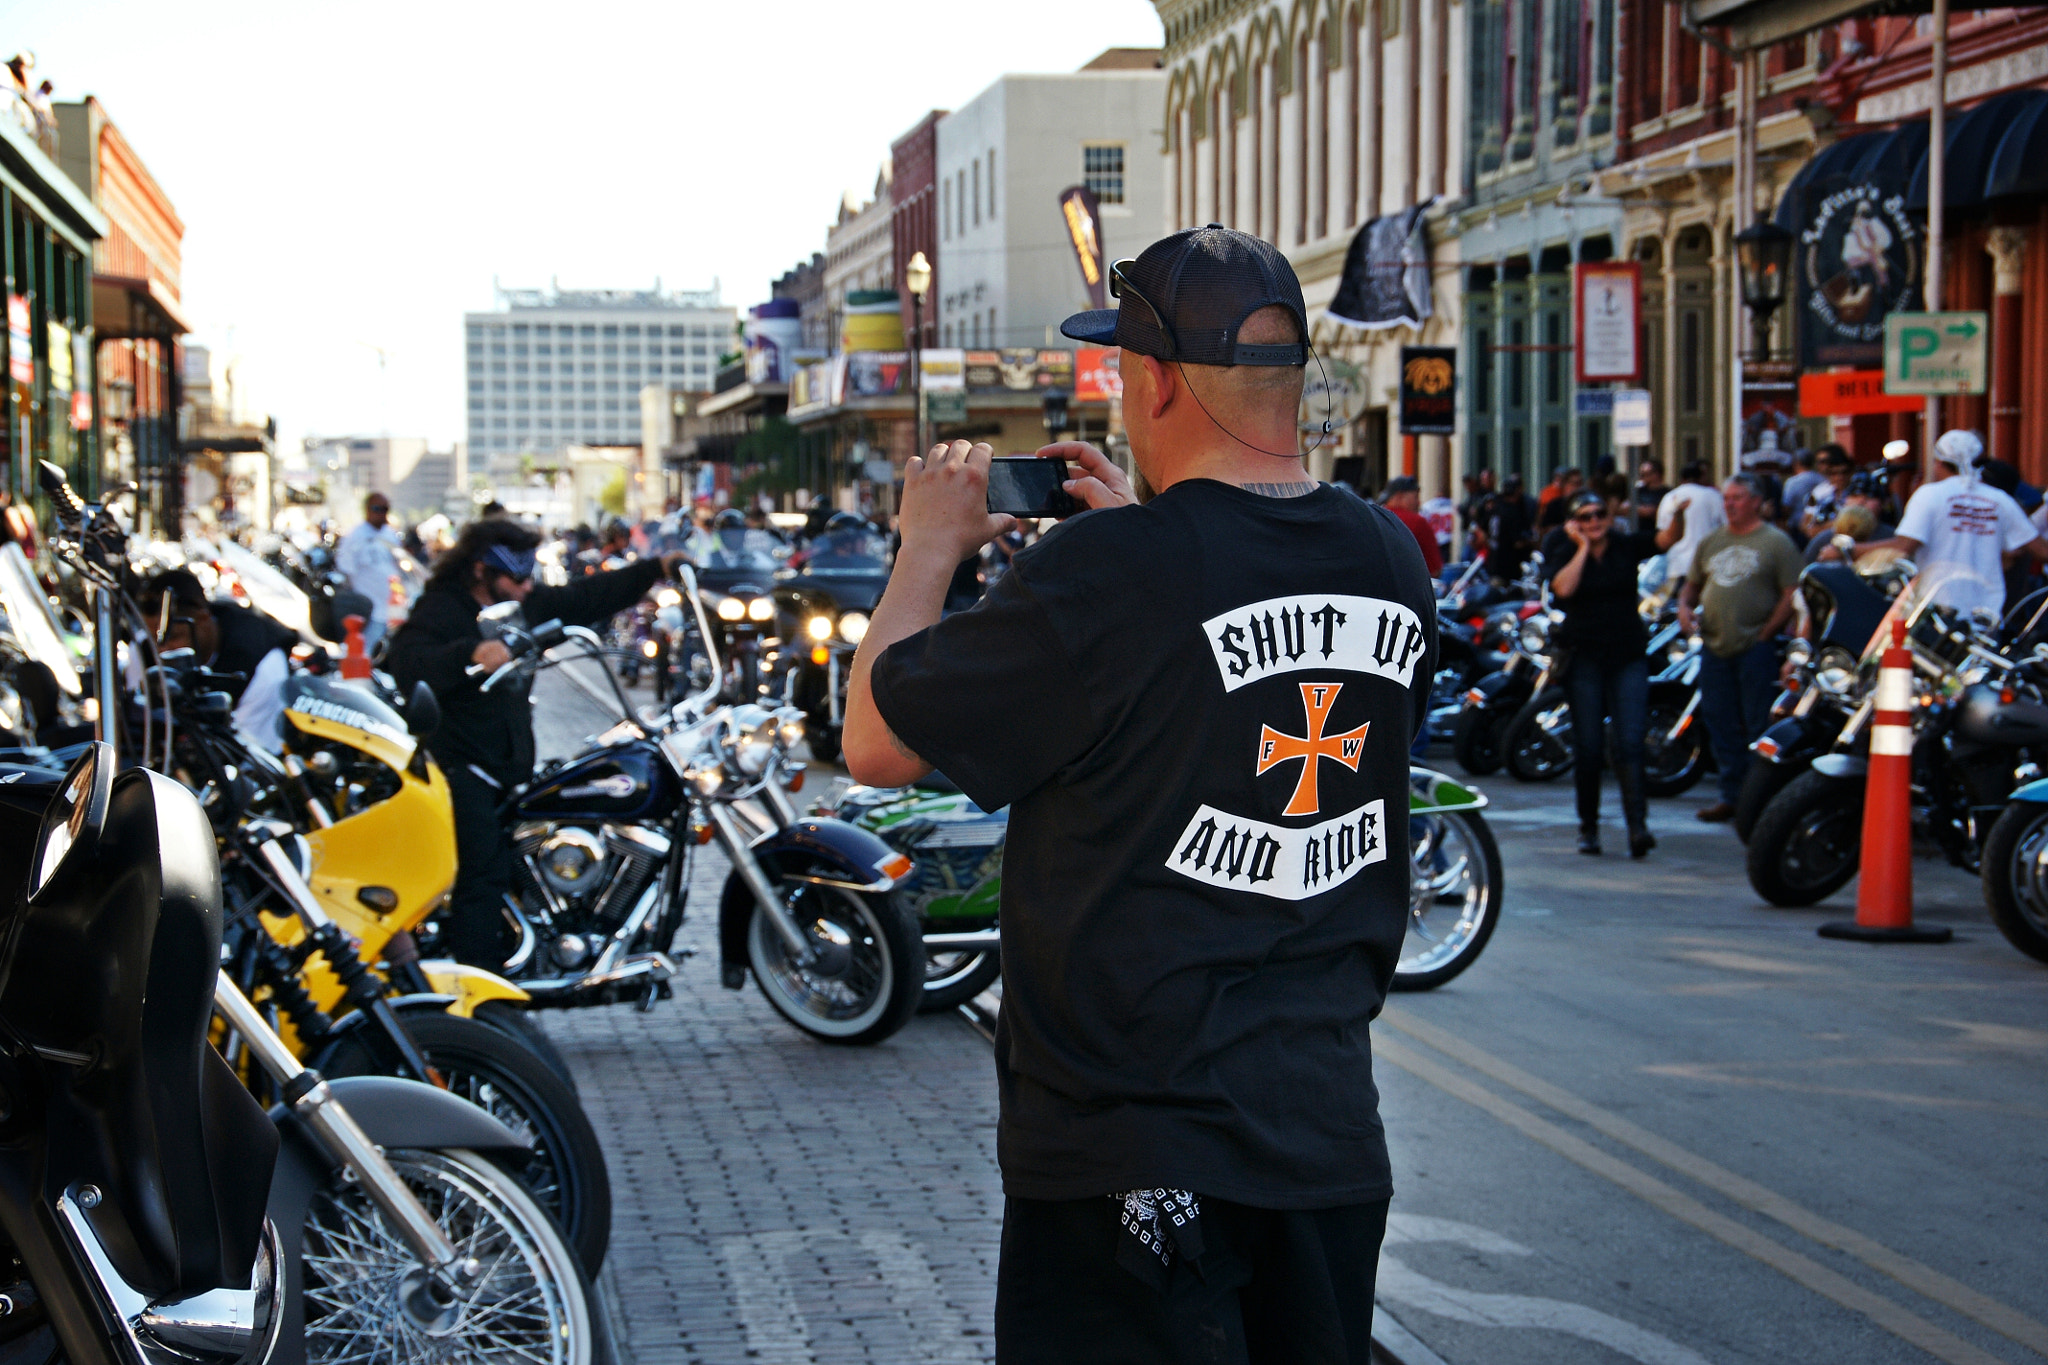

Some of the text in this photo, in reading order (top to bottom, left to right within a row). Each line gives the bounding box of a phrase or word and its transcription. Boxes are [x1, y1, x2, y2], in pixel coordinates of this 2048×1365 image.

[1218, 603, 1424, 678] SHUT UP
[1312, 688, 1326, 708] T
[1262, 739, 1360, 761] F W
[1179, 811, 1378, 890] AND RIDE
